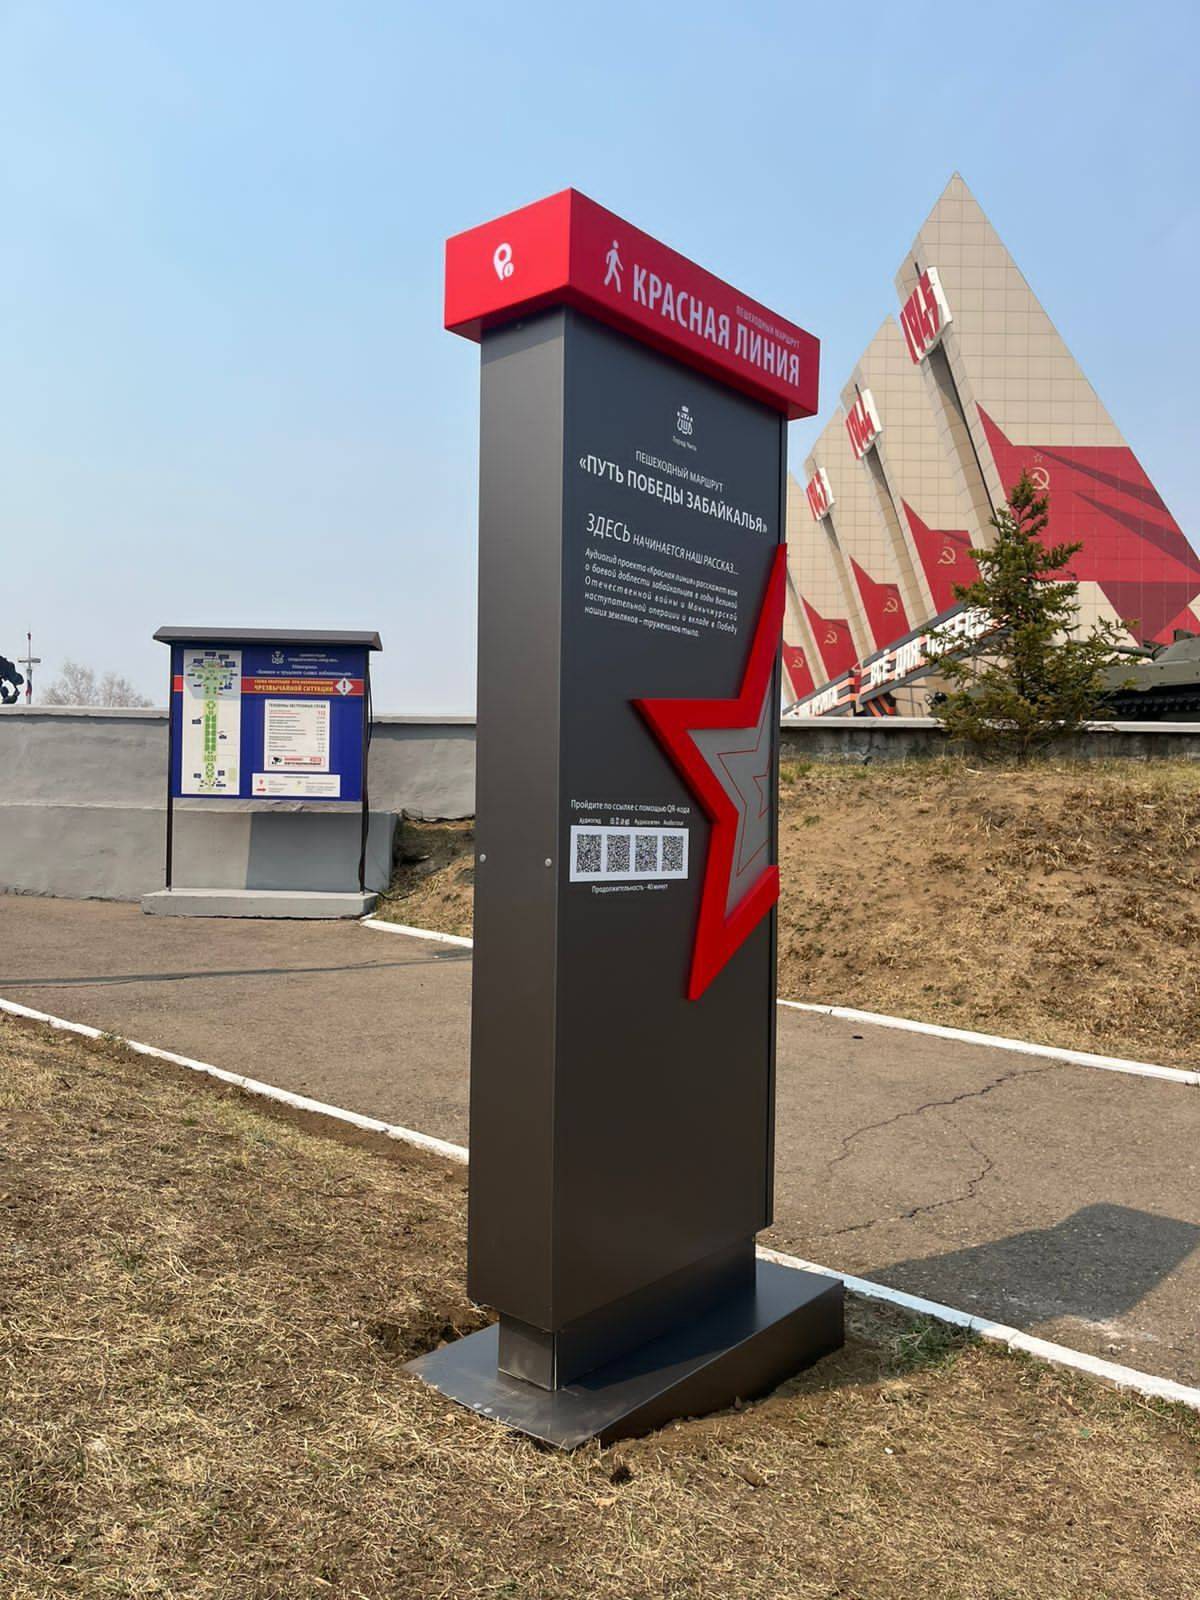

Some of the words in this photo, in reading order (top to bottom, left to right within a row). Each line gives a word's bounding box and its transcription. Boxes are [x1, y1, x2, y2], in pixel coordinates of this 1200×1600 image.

[633, 263, 730, 350] КРАСНАЯ
[735, 322, 800, 387] ЛИНИЯ
[635, 450, 689, 480] ПЕШЕХОДНЫЙ
[689, 472, 723, 493] МАРШРУТ
[579, 454, 624, 484] «ПУТЬ
[627, 469, 684, 505] ПОБЕДЫ
[686, 491, 768, 534] ЗАБАЙКАЛЬЯ»
[586, 512, 631, 543] ЗДЕСЬ
[632, 533, 685, 559] НАЧИНАЕТСЯ
[685, 550, 704, 565] НАШ
[585, 547, 617, 564] Аудиогид
[618, 558, 646, 573] проекта
[592, 563, 616, 578] боевой
[618, 570, 650, 587] доблести
[585, 575, 652, 600] Отечественной
[585, 591, 647, 613] наступательной
[870, 647, 894, 686] ВСЁ
[895, 637, 921, 680] ДЛЯ
[570, 799, 603, 811] Пройдите
[603, 802, 612, 810] по
[612, 803, 634, 811] ссылке
